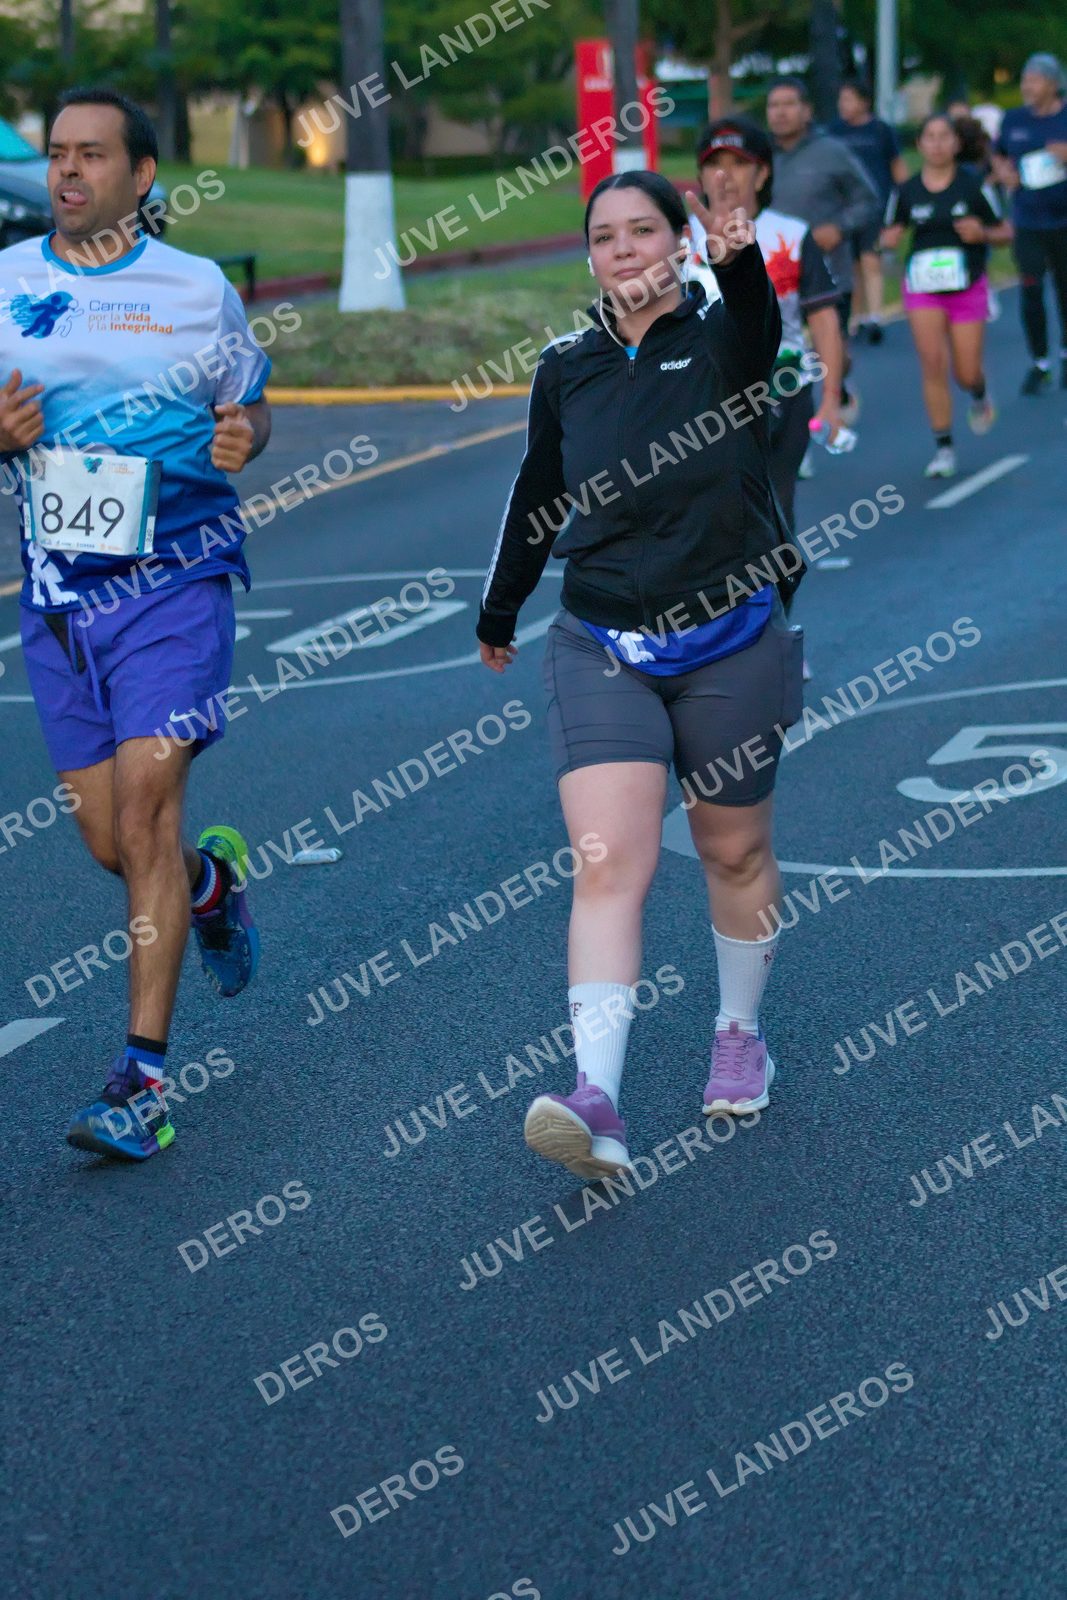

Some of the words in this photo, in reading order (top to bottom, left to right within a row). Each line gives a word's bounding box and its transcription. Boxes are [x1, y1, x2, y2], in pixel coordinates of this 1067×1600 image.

[89, 300, 150, 312] Carrera
[88, 313, 107, 324] por
[111, 313, 121, 322] la
[124, 313, 151, 323] Vida
[110, 322, 173, 335] Integridad
[41, 492, 125, 539] 849
